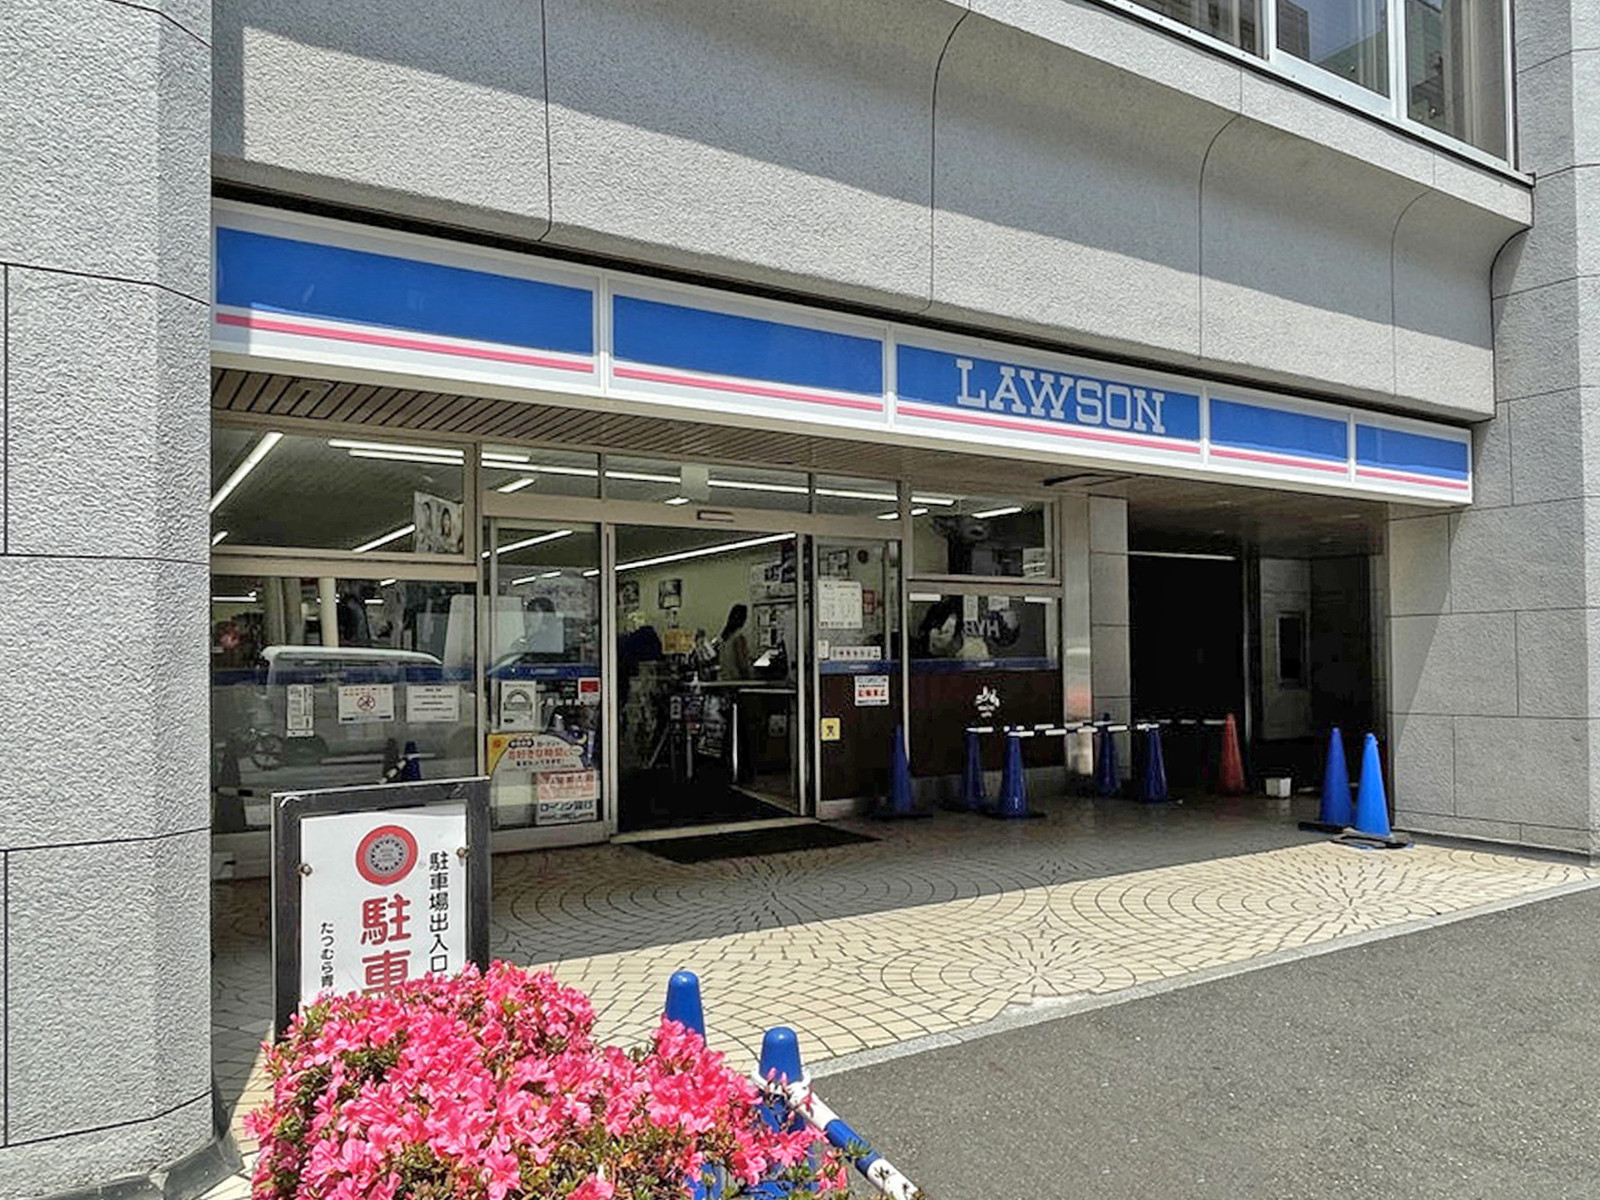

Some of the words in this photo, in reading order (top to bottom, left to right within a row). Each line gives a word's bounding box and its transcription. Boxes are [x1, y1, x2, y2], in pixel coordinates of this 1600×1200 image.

[956, 358, 1166, 434] LAWSON
[361, 893, 412, 994] 駐車
[429, 850, 449, 973] 駐車場出入口
